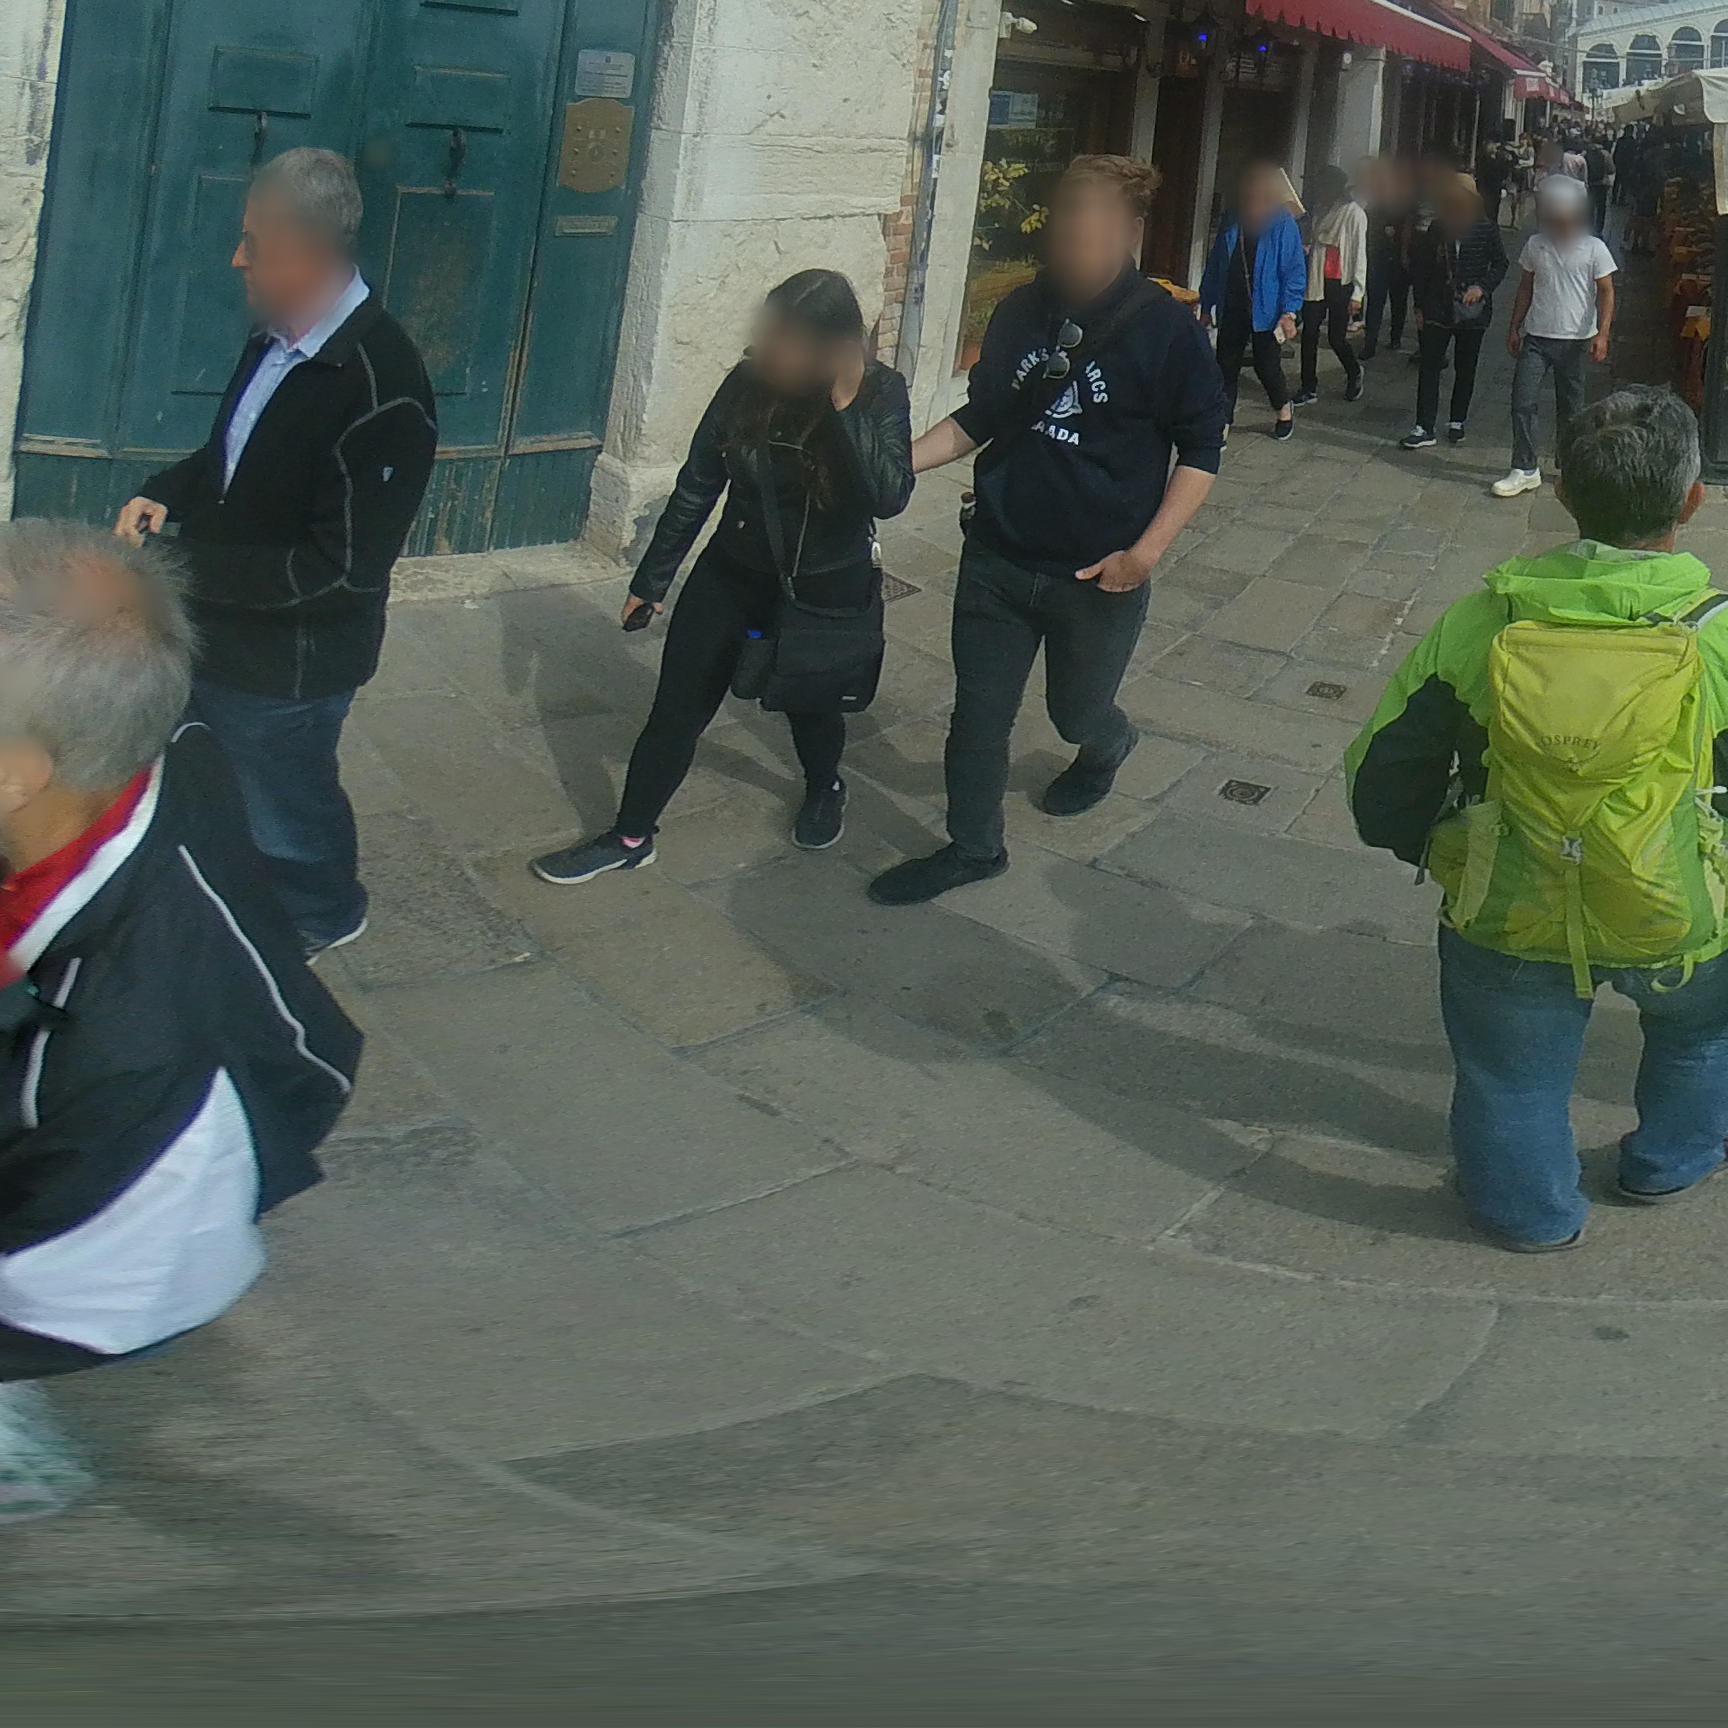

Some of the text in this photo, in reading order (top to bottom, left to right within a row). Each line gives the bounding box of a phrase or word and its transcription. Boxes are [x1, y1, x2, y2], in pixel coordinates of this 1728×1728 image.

[1011, 347, 1050, 390] PARKS
[1085, 360, 1109, 403] ARCS
[1540, 733, 1601, 751] OSPREY
